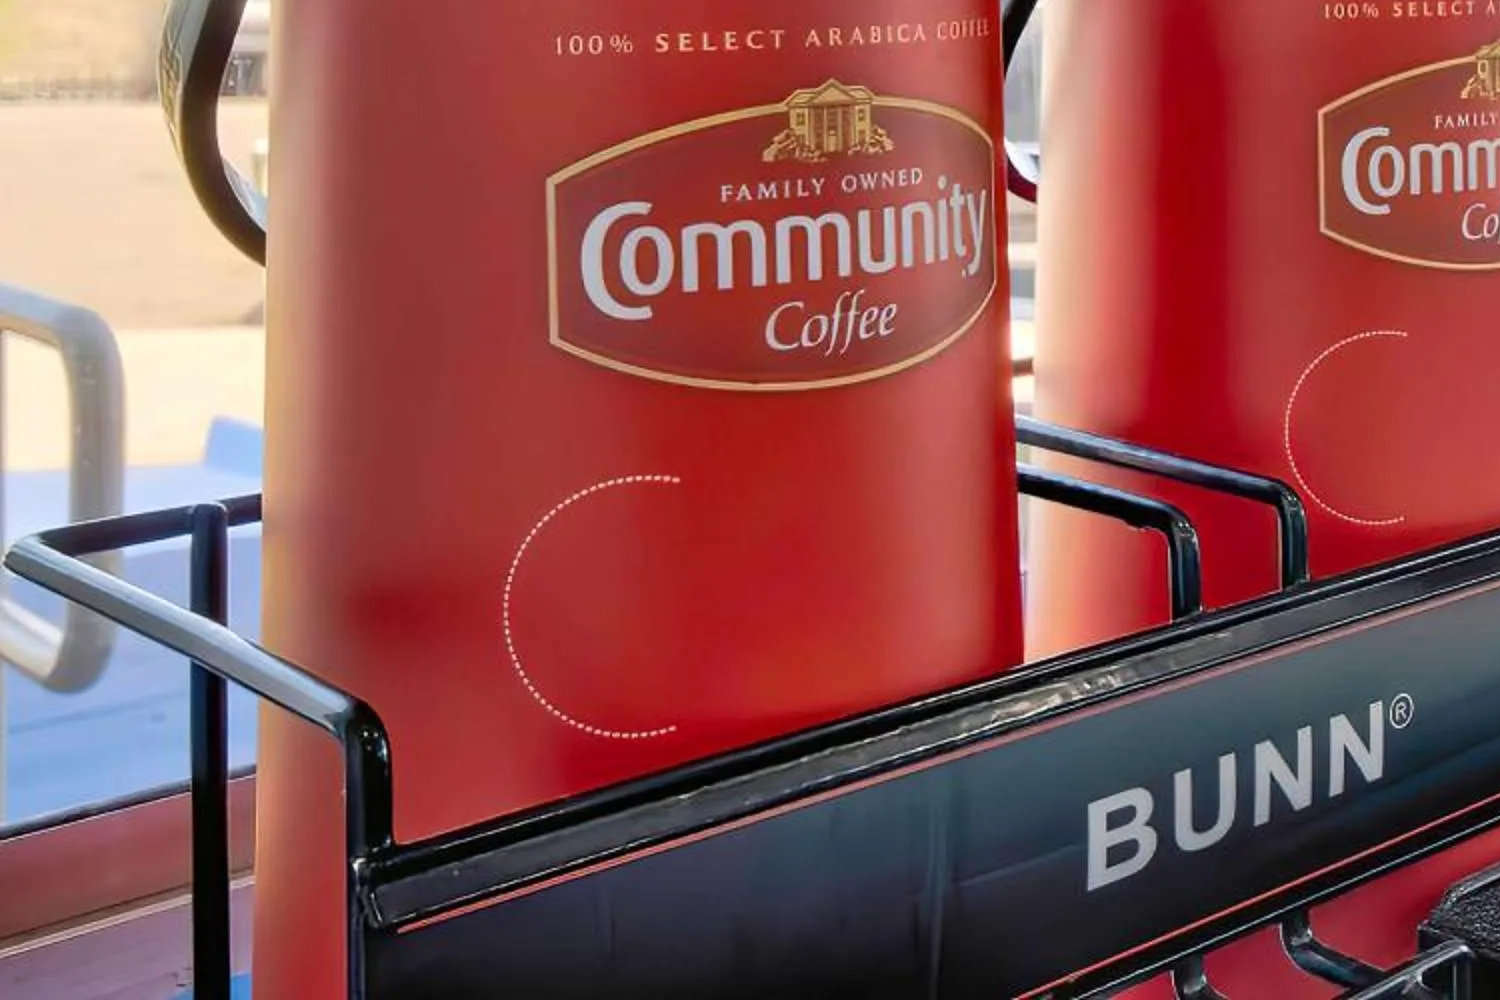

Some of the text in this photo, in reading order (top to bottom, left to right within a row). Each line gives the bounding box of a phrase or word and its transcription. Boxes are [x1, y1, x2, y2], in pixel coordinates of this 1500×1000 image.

[1323, 2, 1379, 20] 100%
[1392, 0, 1475, 18] SELECT
[555, 18, 991, 55] 100% SELECT ARABICA COFFEE
[1434, 113, 1498, 130] FAMILY
[720, 168, 923, 204] FAMILY OWNED
[580, 175, 987, 321] Community
[764, 288, 898, 355] Coffee
